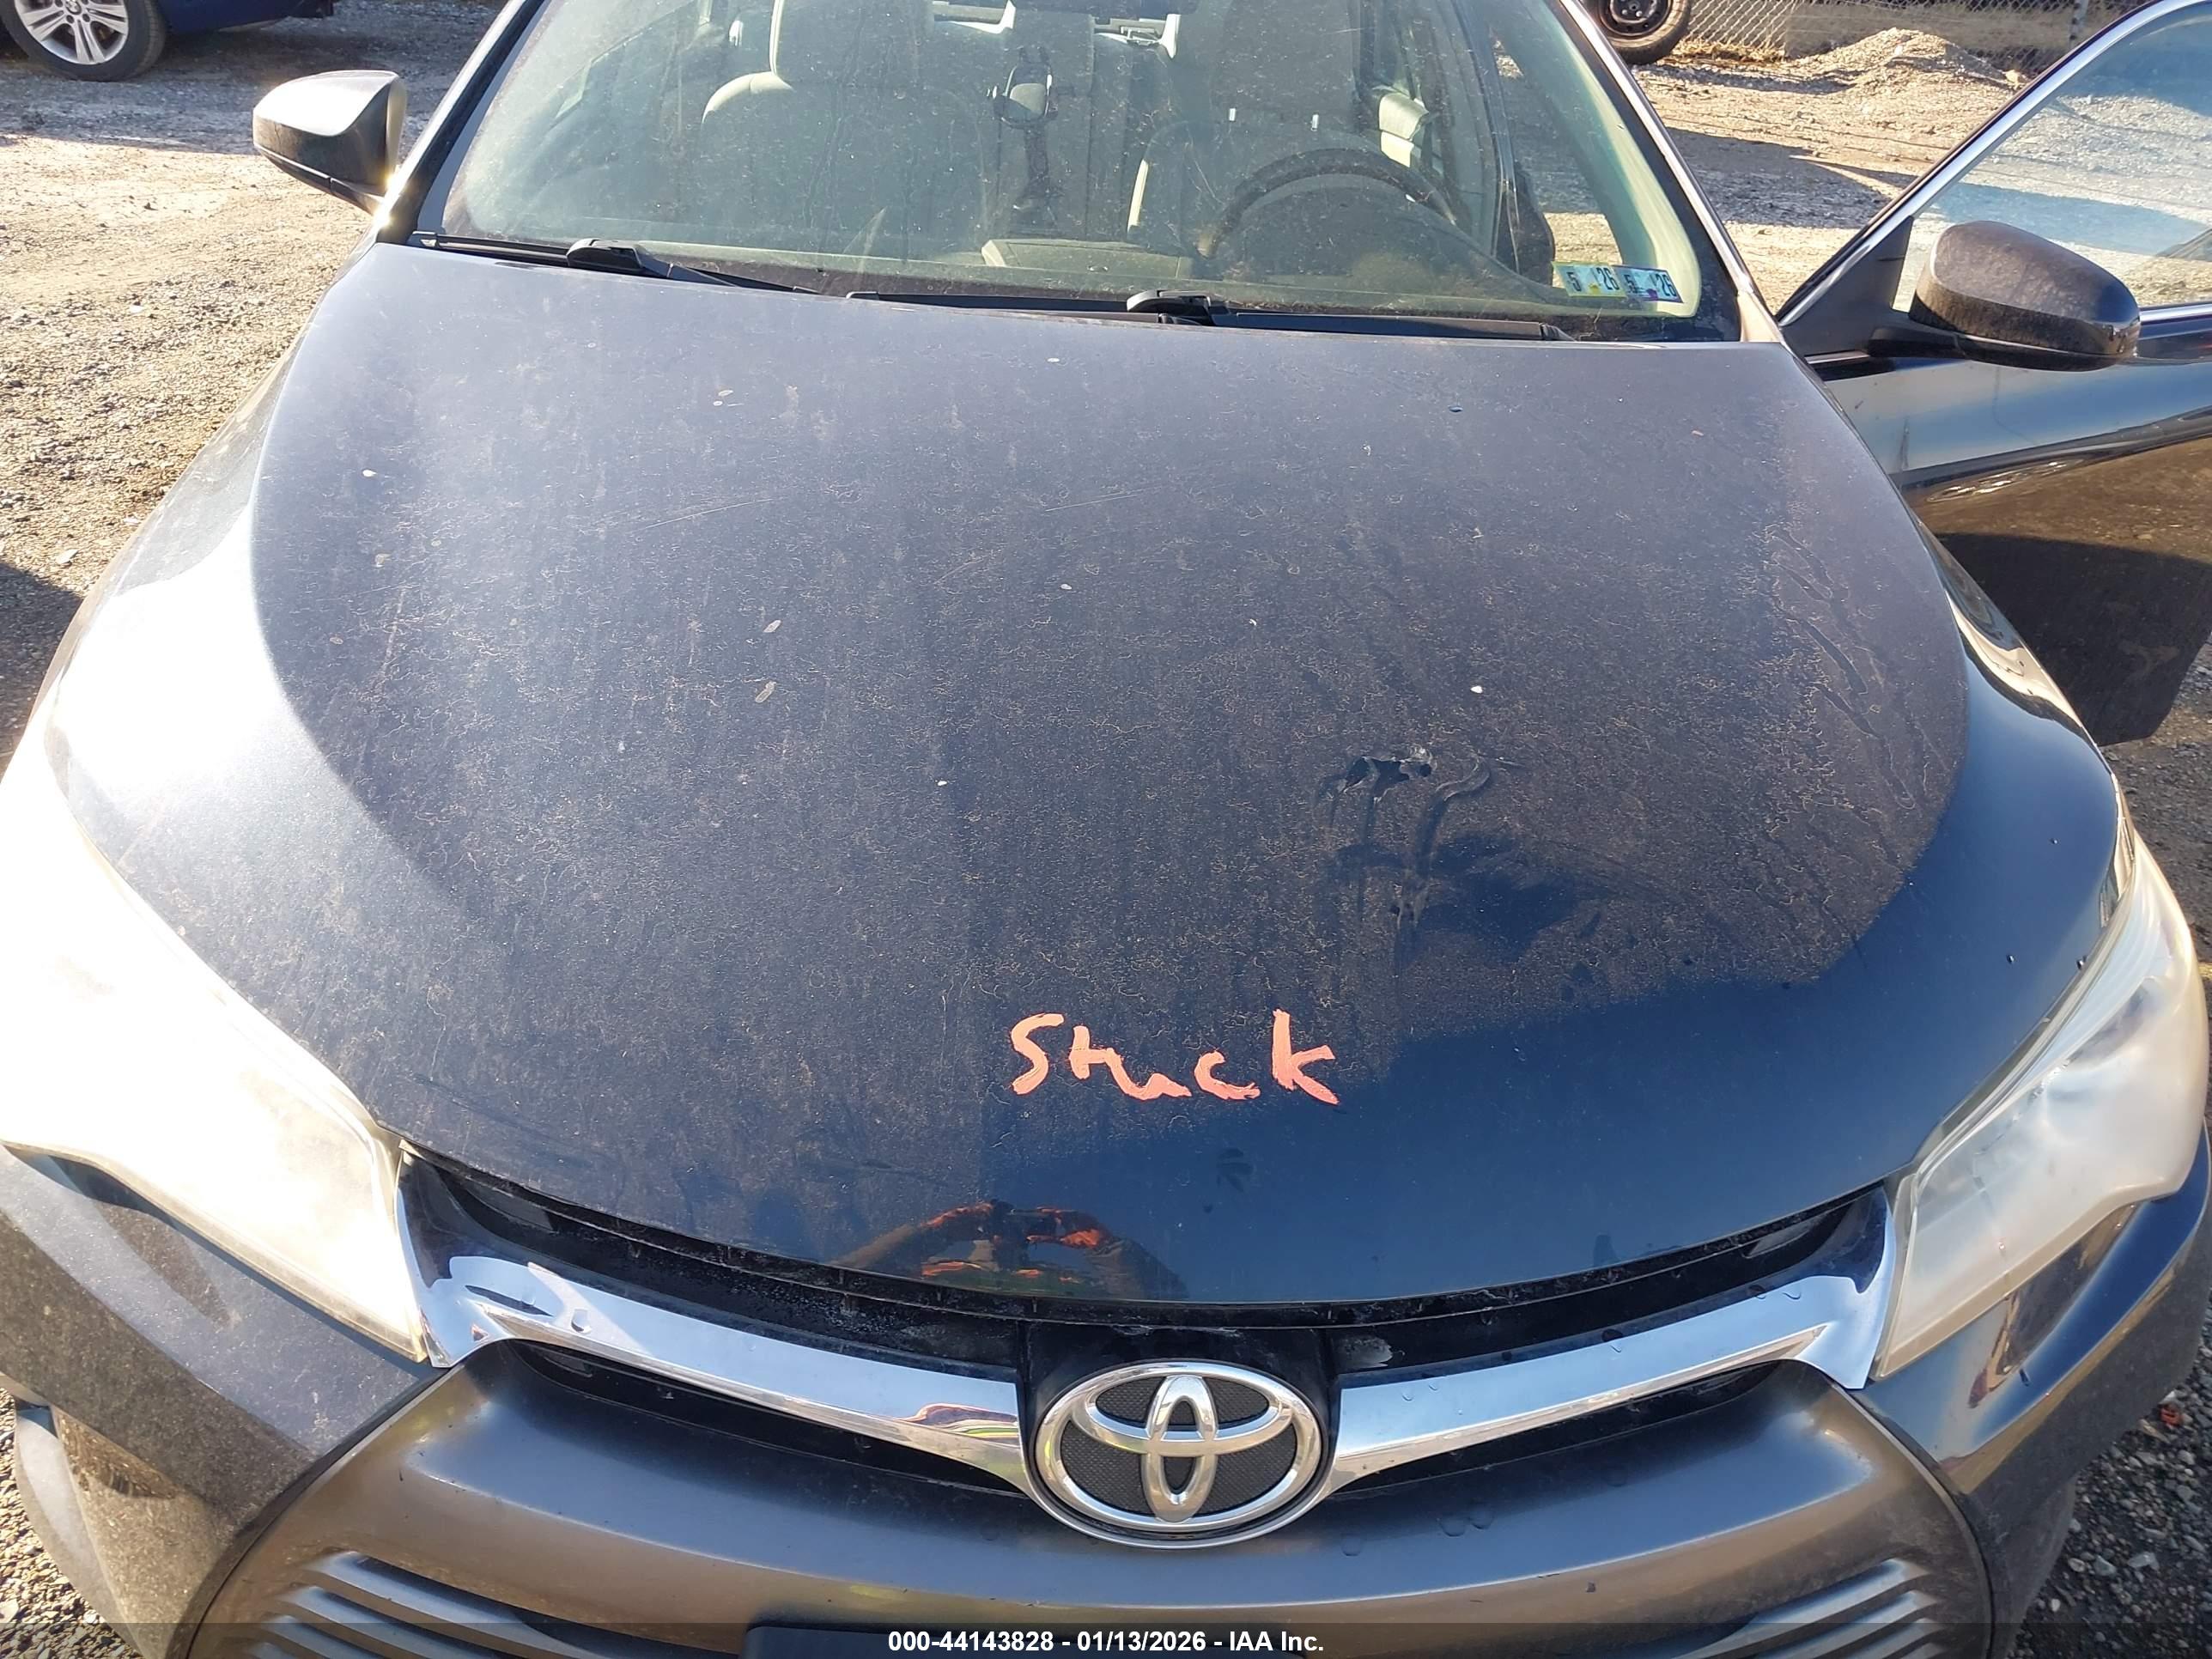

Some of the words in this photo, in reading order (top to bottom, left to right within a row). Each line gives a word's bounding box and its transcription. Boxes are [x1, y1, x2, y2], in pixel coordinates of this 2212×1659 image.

[1566, 271, 1582, 292] 5
[1624, 274, 1638, 294] 5
[1011, 1009, 1340, 1104] Stuck
